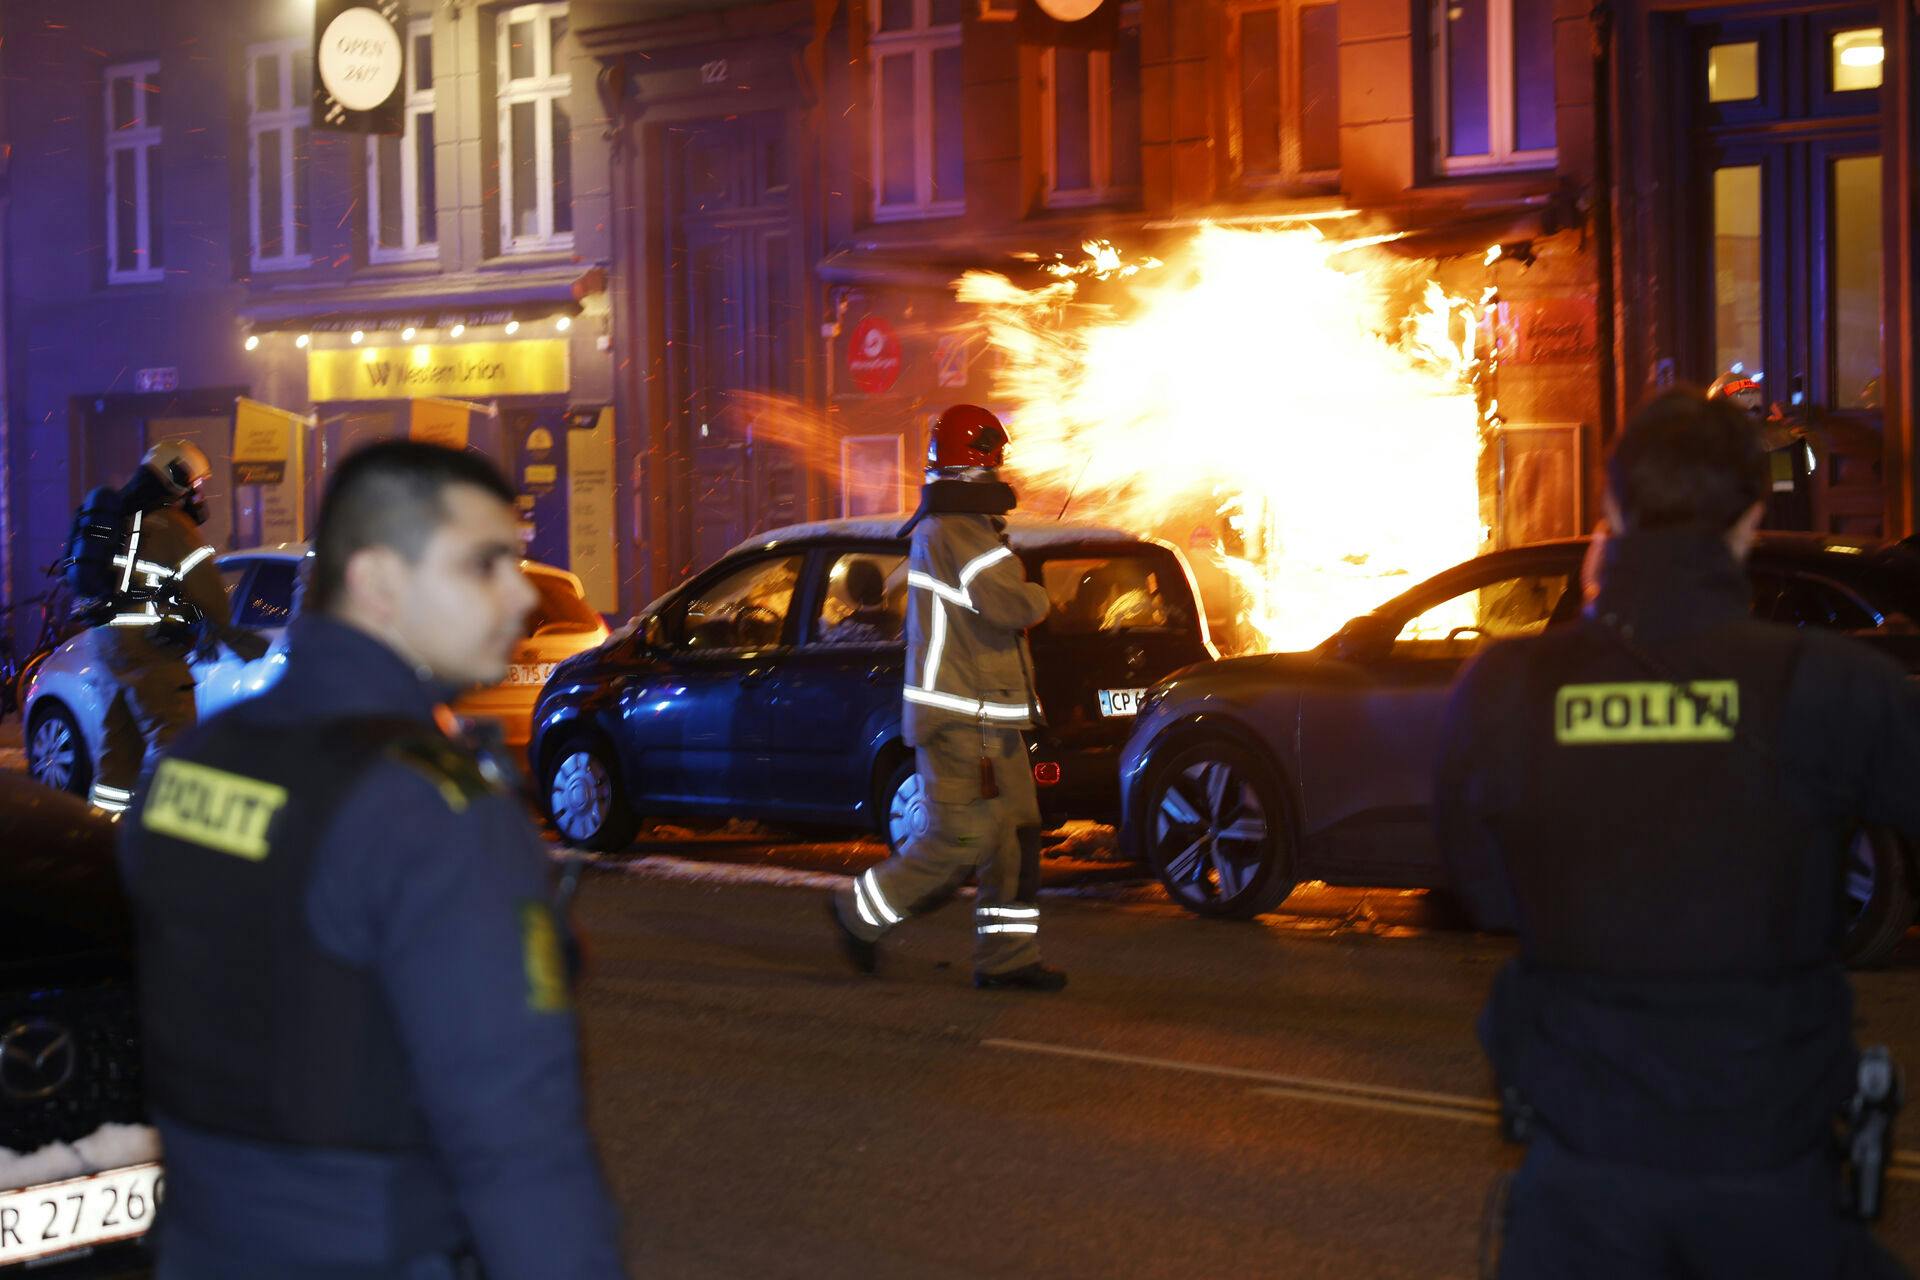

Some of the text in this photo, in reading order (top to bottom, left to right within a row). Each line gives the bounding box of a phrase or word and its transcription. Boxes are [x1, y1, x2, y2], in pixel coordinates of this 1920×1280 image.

[336, 36, 383, 56] OPEN
[701, 60, 728, 83] 122
[460, 358, 505, 382] Union
[1111, 692, 1131, 711] CP
[1564, 691, 1730, 731] POLITI
[0, 1207, 23, 1248] R
[40, 1194, 85, 1240] 27
